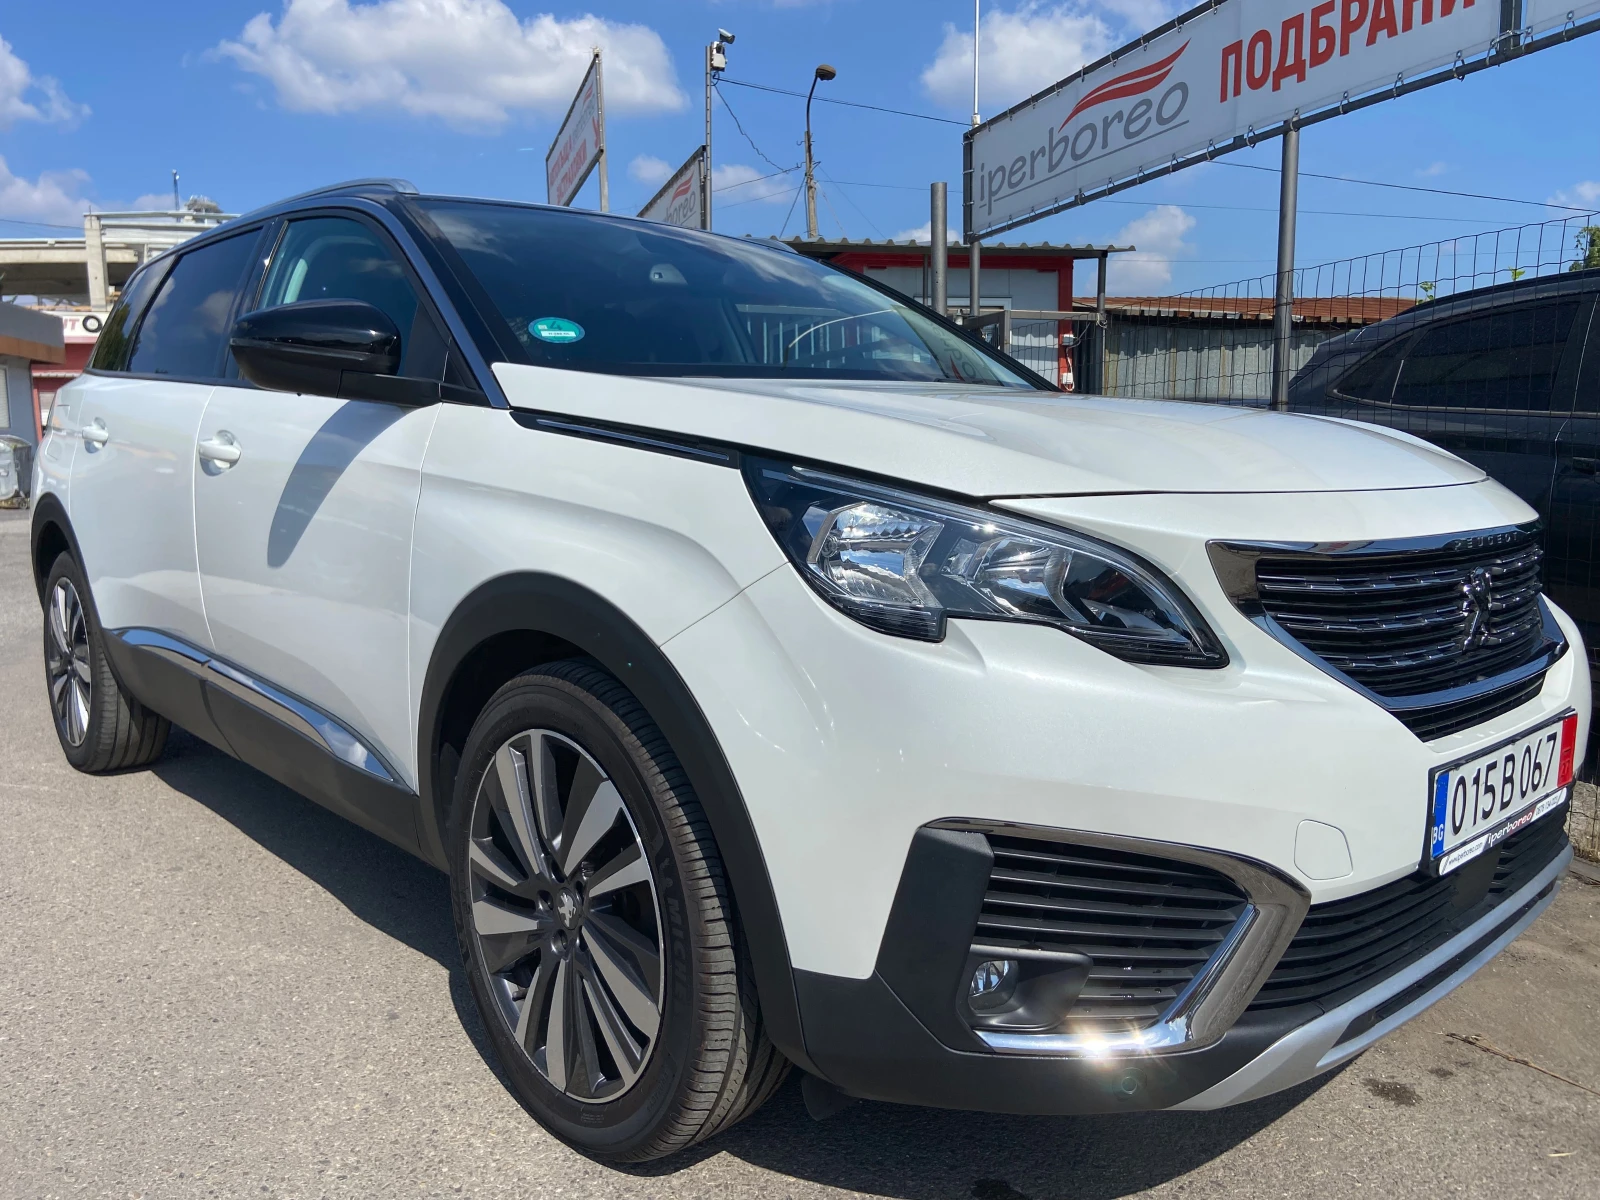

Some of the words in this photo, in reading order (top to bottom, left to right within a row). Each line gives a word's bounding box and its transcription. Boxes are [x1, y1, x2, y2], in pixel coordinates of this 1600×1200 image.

[1220, 0, 1476, 104] ПОДБРАН
[980, 81, 1189, 216] iperboreo
[1454, 532, 1518, 552] PEUGEOT
[1432, 823, 1444, 845] BG
[1488, 812, 1533, 848] iperboreo
